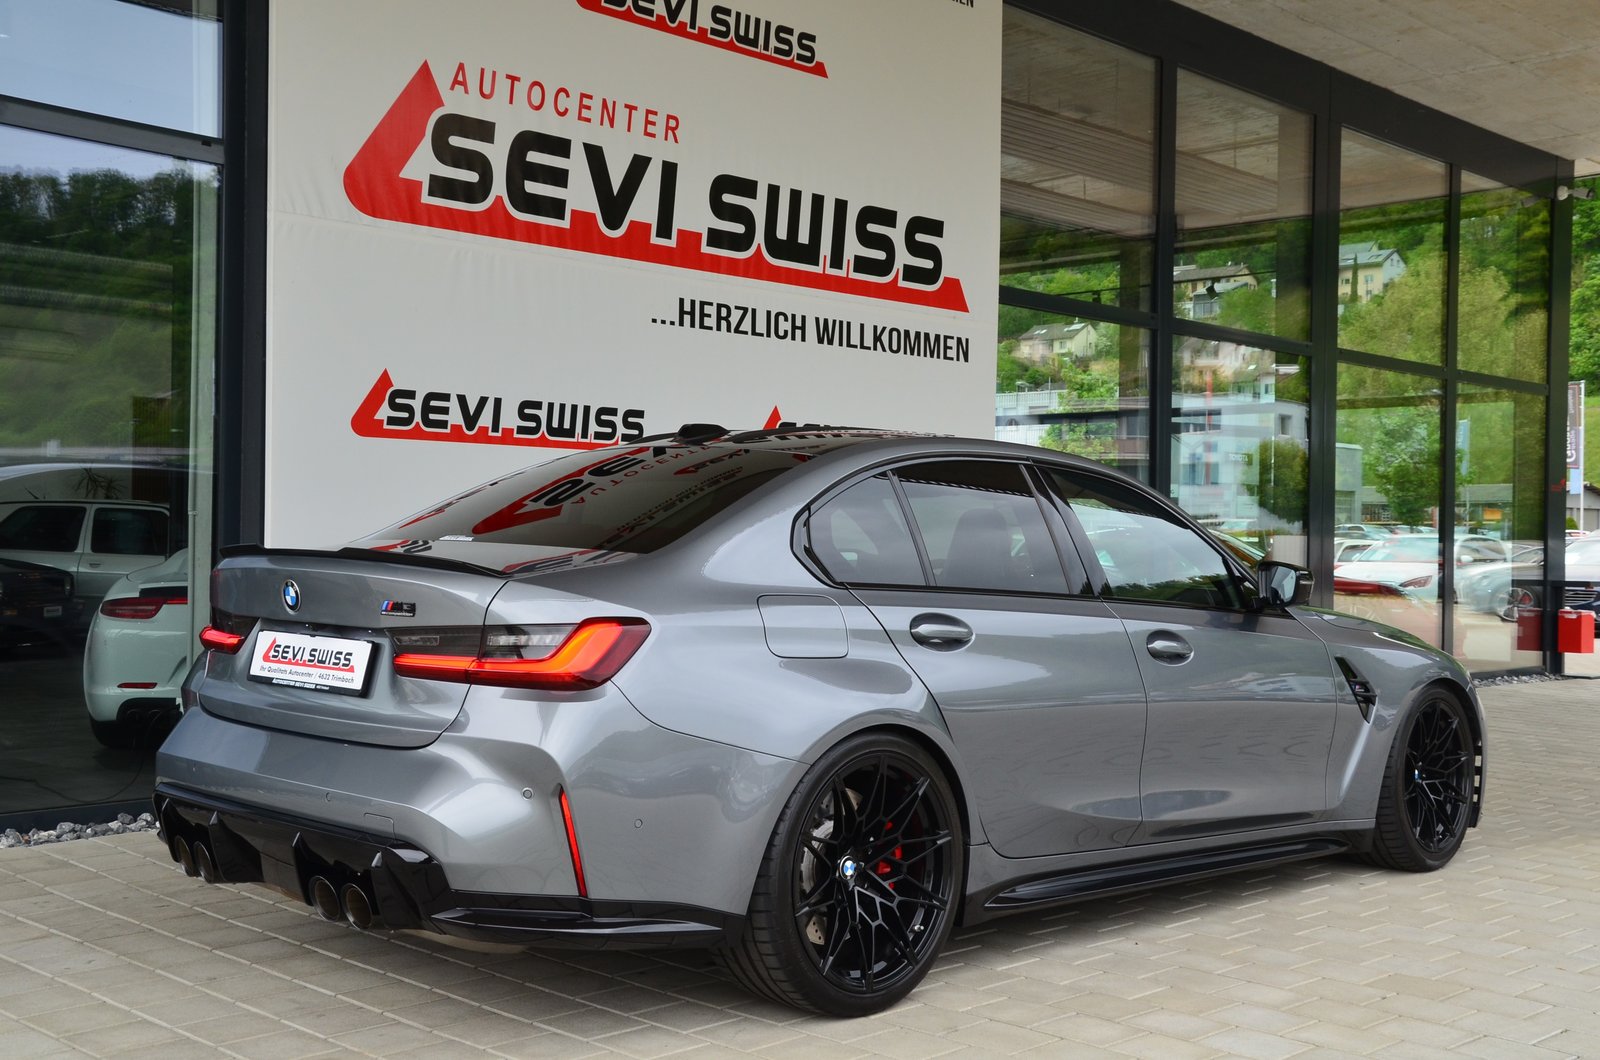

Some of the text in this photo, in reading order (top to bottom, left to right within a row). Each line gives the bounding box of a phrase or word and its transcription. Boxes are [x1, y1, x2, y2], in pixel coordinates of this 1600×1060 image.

[709, 5, 817, 64] SWISS
[449, 61, 680, 144] AUTOCENTER
[427, 112, 945, 286] SEVI SWISS
[814, 315, 970, 363] WILLKOMMEN
[385, 388, 645, 443] SEVI SWISS
[271, 643, 353, 668] SEVI SWISS
